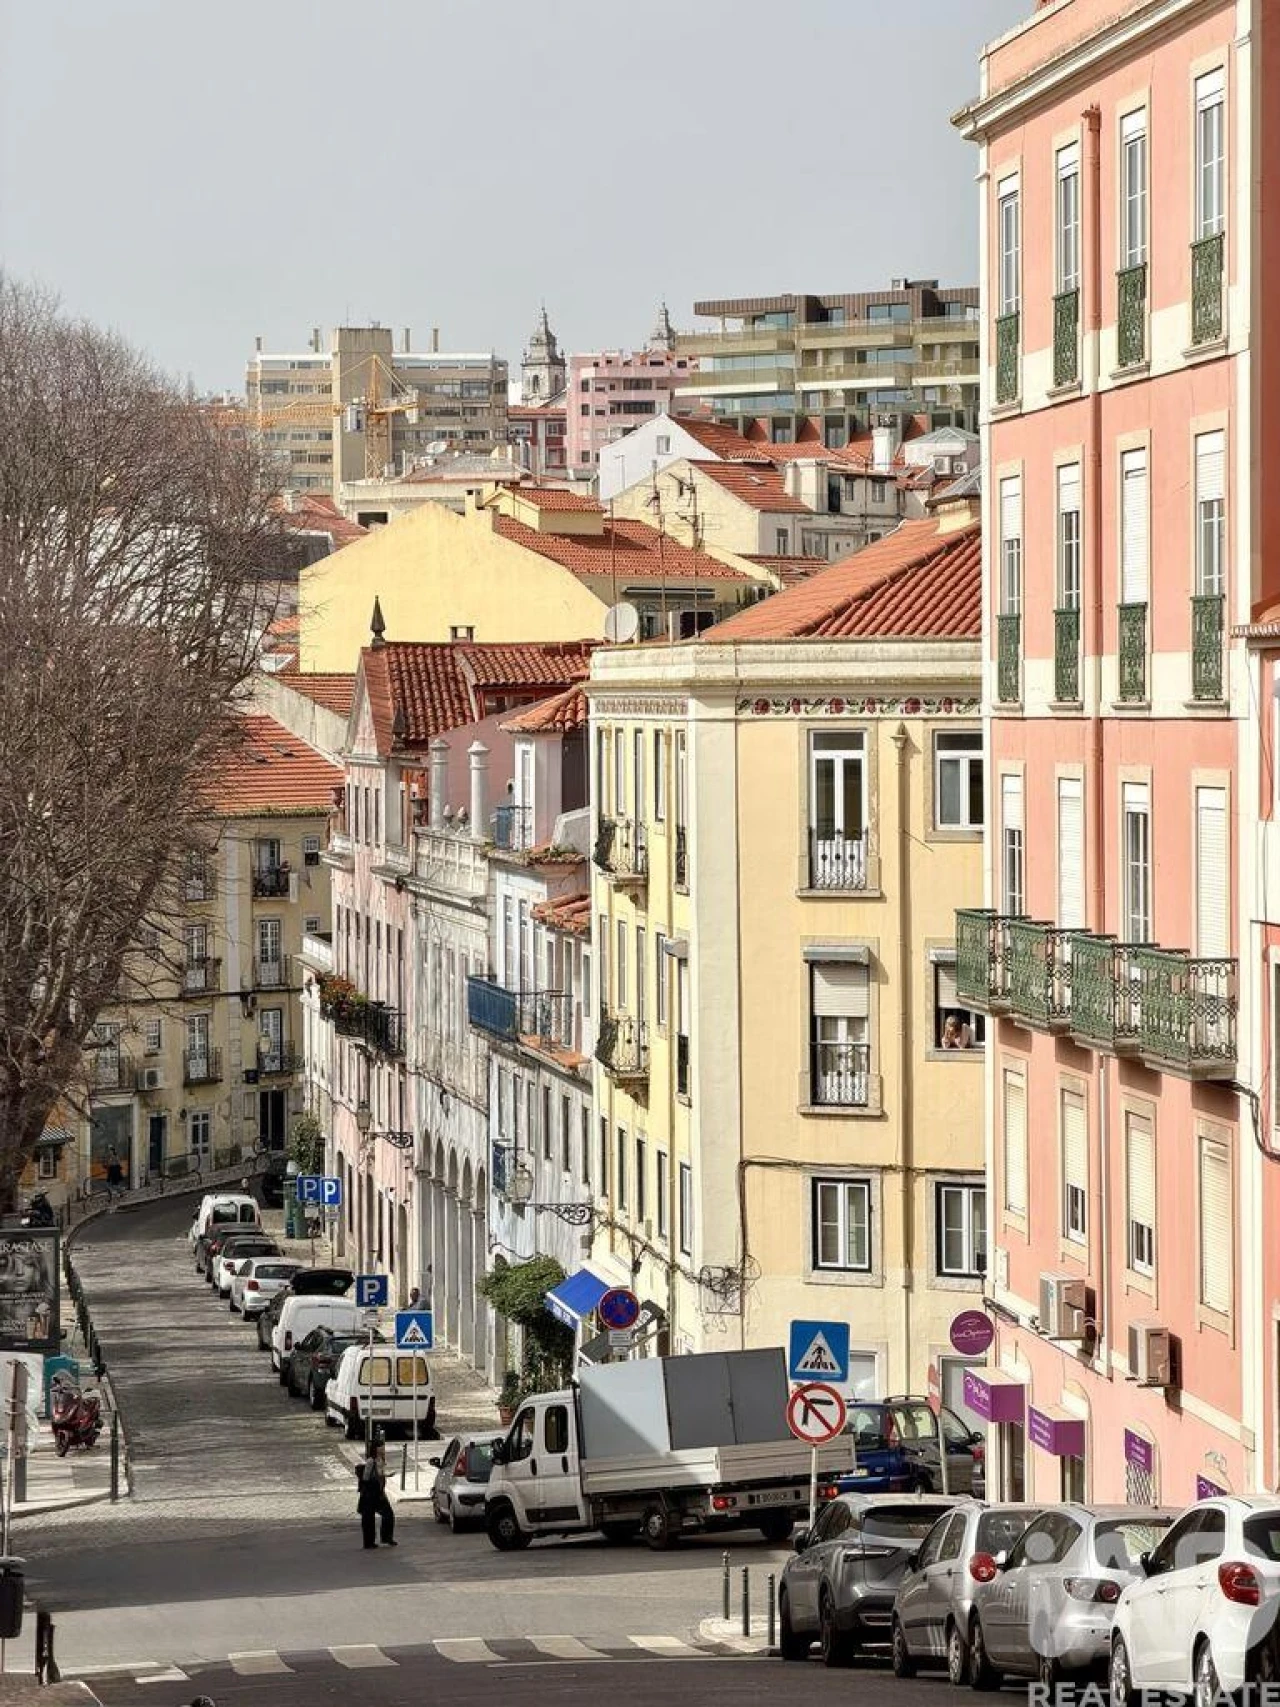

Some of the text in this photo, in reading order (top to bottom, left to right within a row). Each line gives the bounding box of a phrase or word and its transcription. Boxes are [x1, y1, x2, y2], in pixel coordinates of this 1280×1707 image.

[304, 1179, 317, 1199] P
[325, 1181, 337, 1203] P
[362, 1279, 381, 1303] P
